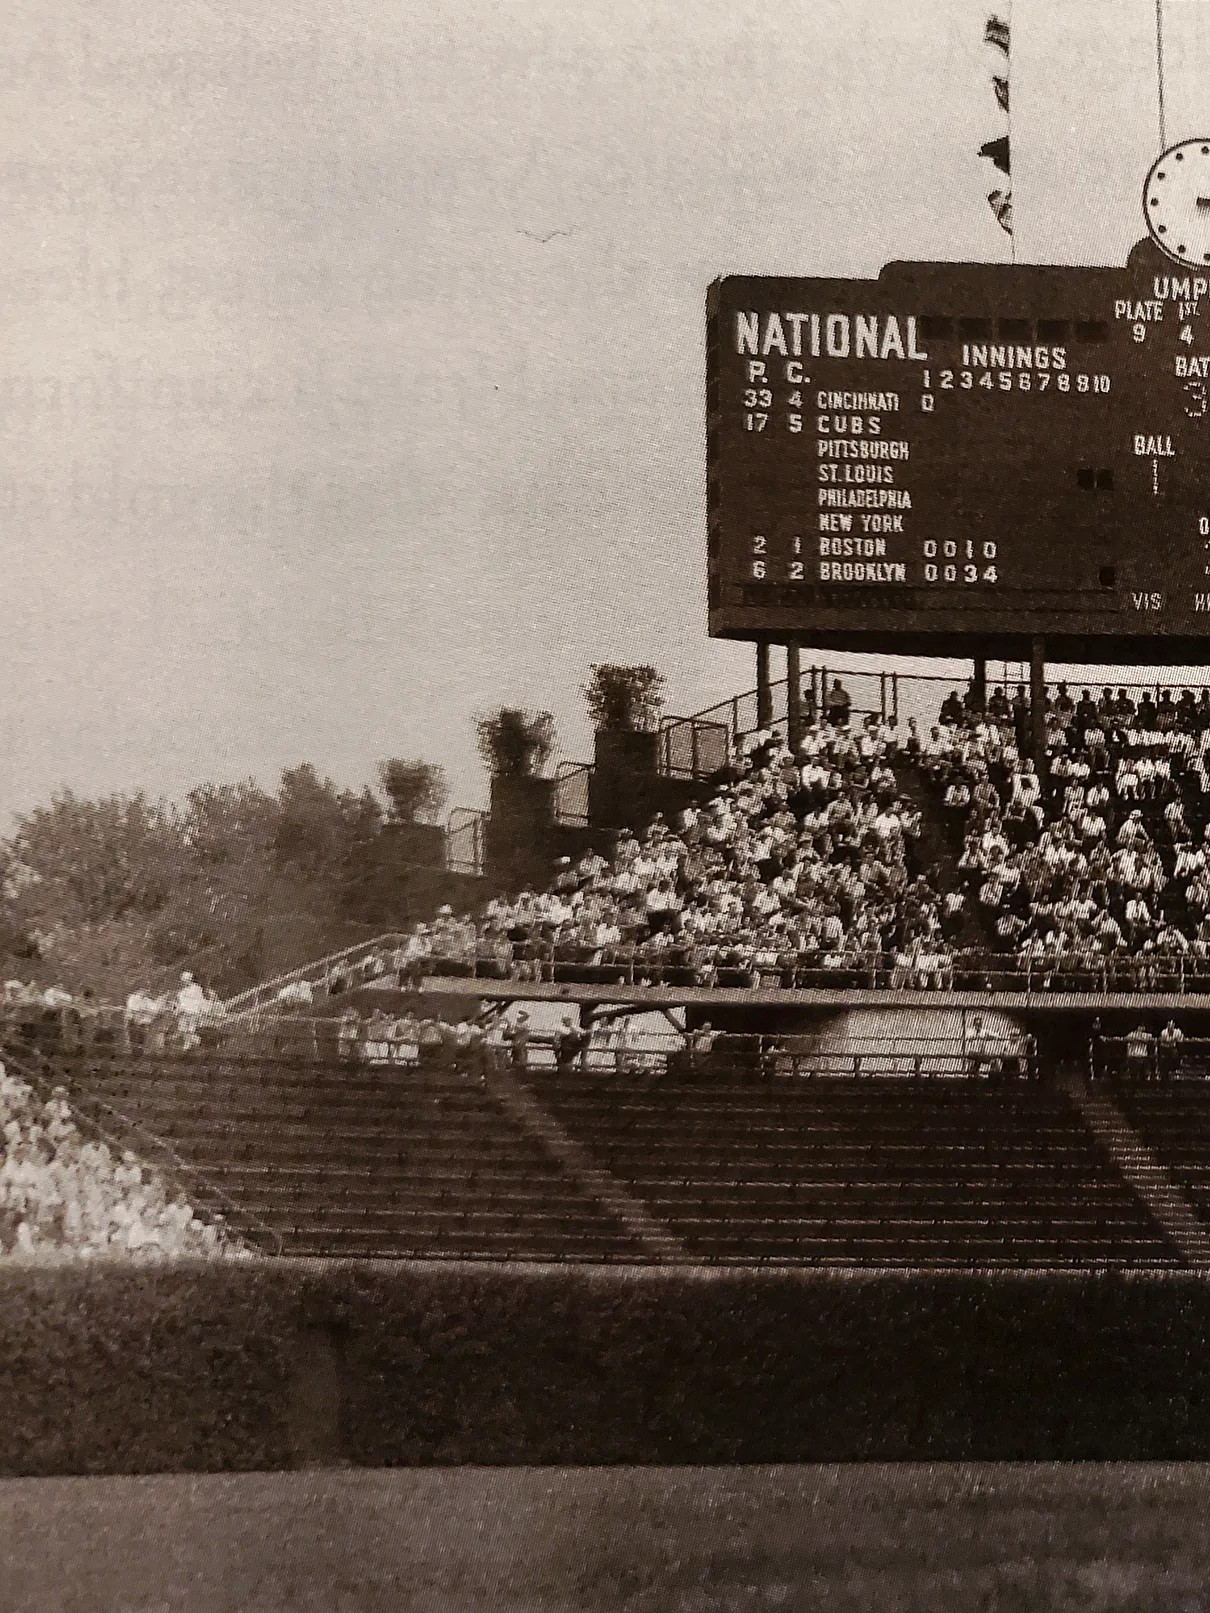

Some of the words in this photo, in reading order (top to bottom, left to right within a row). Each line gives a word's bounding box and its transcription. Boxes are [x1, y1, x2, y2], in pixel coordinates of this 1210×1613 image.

[1114, 299, 1164, 322] PLATE
[736, 311, 928, 360] NATIONAL
[1132, 323, 1146, 343] 9
[1179, 324, 1195, 345] 4
[962, 344, 1067, 370] INNINGS
[748, 360, 768, 384] P.
[786, 361, 811, 384] C.
[923, 369, 930, 388] 1
[939, 369, 954, 389] 2
[960, 371, 973, 389] 3
[978, 371, 994, 390] 4
[998, 371, 1012, 391] 5
[1037, 372, 1051, 391] 7
[1057, 373, 1071, 392] 8
[1093, 374, 1111, 393] 10
[744, 388, 773, 408] 33
[787, 390, 803, 408] 4
[817, 390, 899, 411] CINCINNATI
[746, 412, 769, 432] 17
[788, 413, 803, 433] 5
[817, 414, 881, 435] CUBS
[817, 439, 910, 460] PITTSBURGH
[1134, 434, 1175, 456] BALL
[818, 488, 912, 509] PHILADELPHIA
[819, 513, 853, 532] NEW
[860, 514, 904, 533] YORK
[753, 535, 767, 554] 2
[819, 536, 886, 557] BOSTON
[923, 539, 937, 558] 0
[943, 540, 957, 558] 0
[965, 539, 974, 559] 1
[983, 541, 997, 559] 0
[752, 560, 766, 579] 6
[789, 561, 804, 580] 2
[819, 561, 906, 582] BROOKLYN
[924, 563, 938, 582] 0
[943, 564, 957, 582] 0
[964, 564, 978, 583] 3
[982, 565, 998, 583] 4
[1131, 592, 1162, 611] VIS
